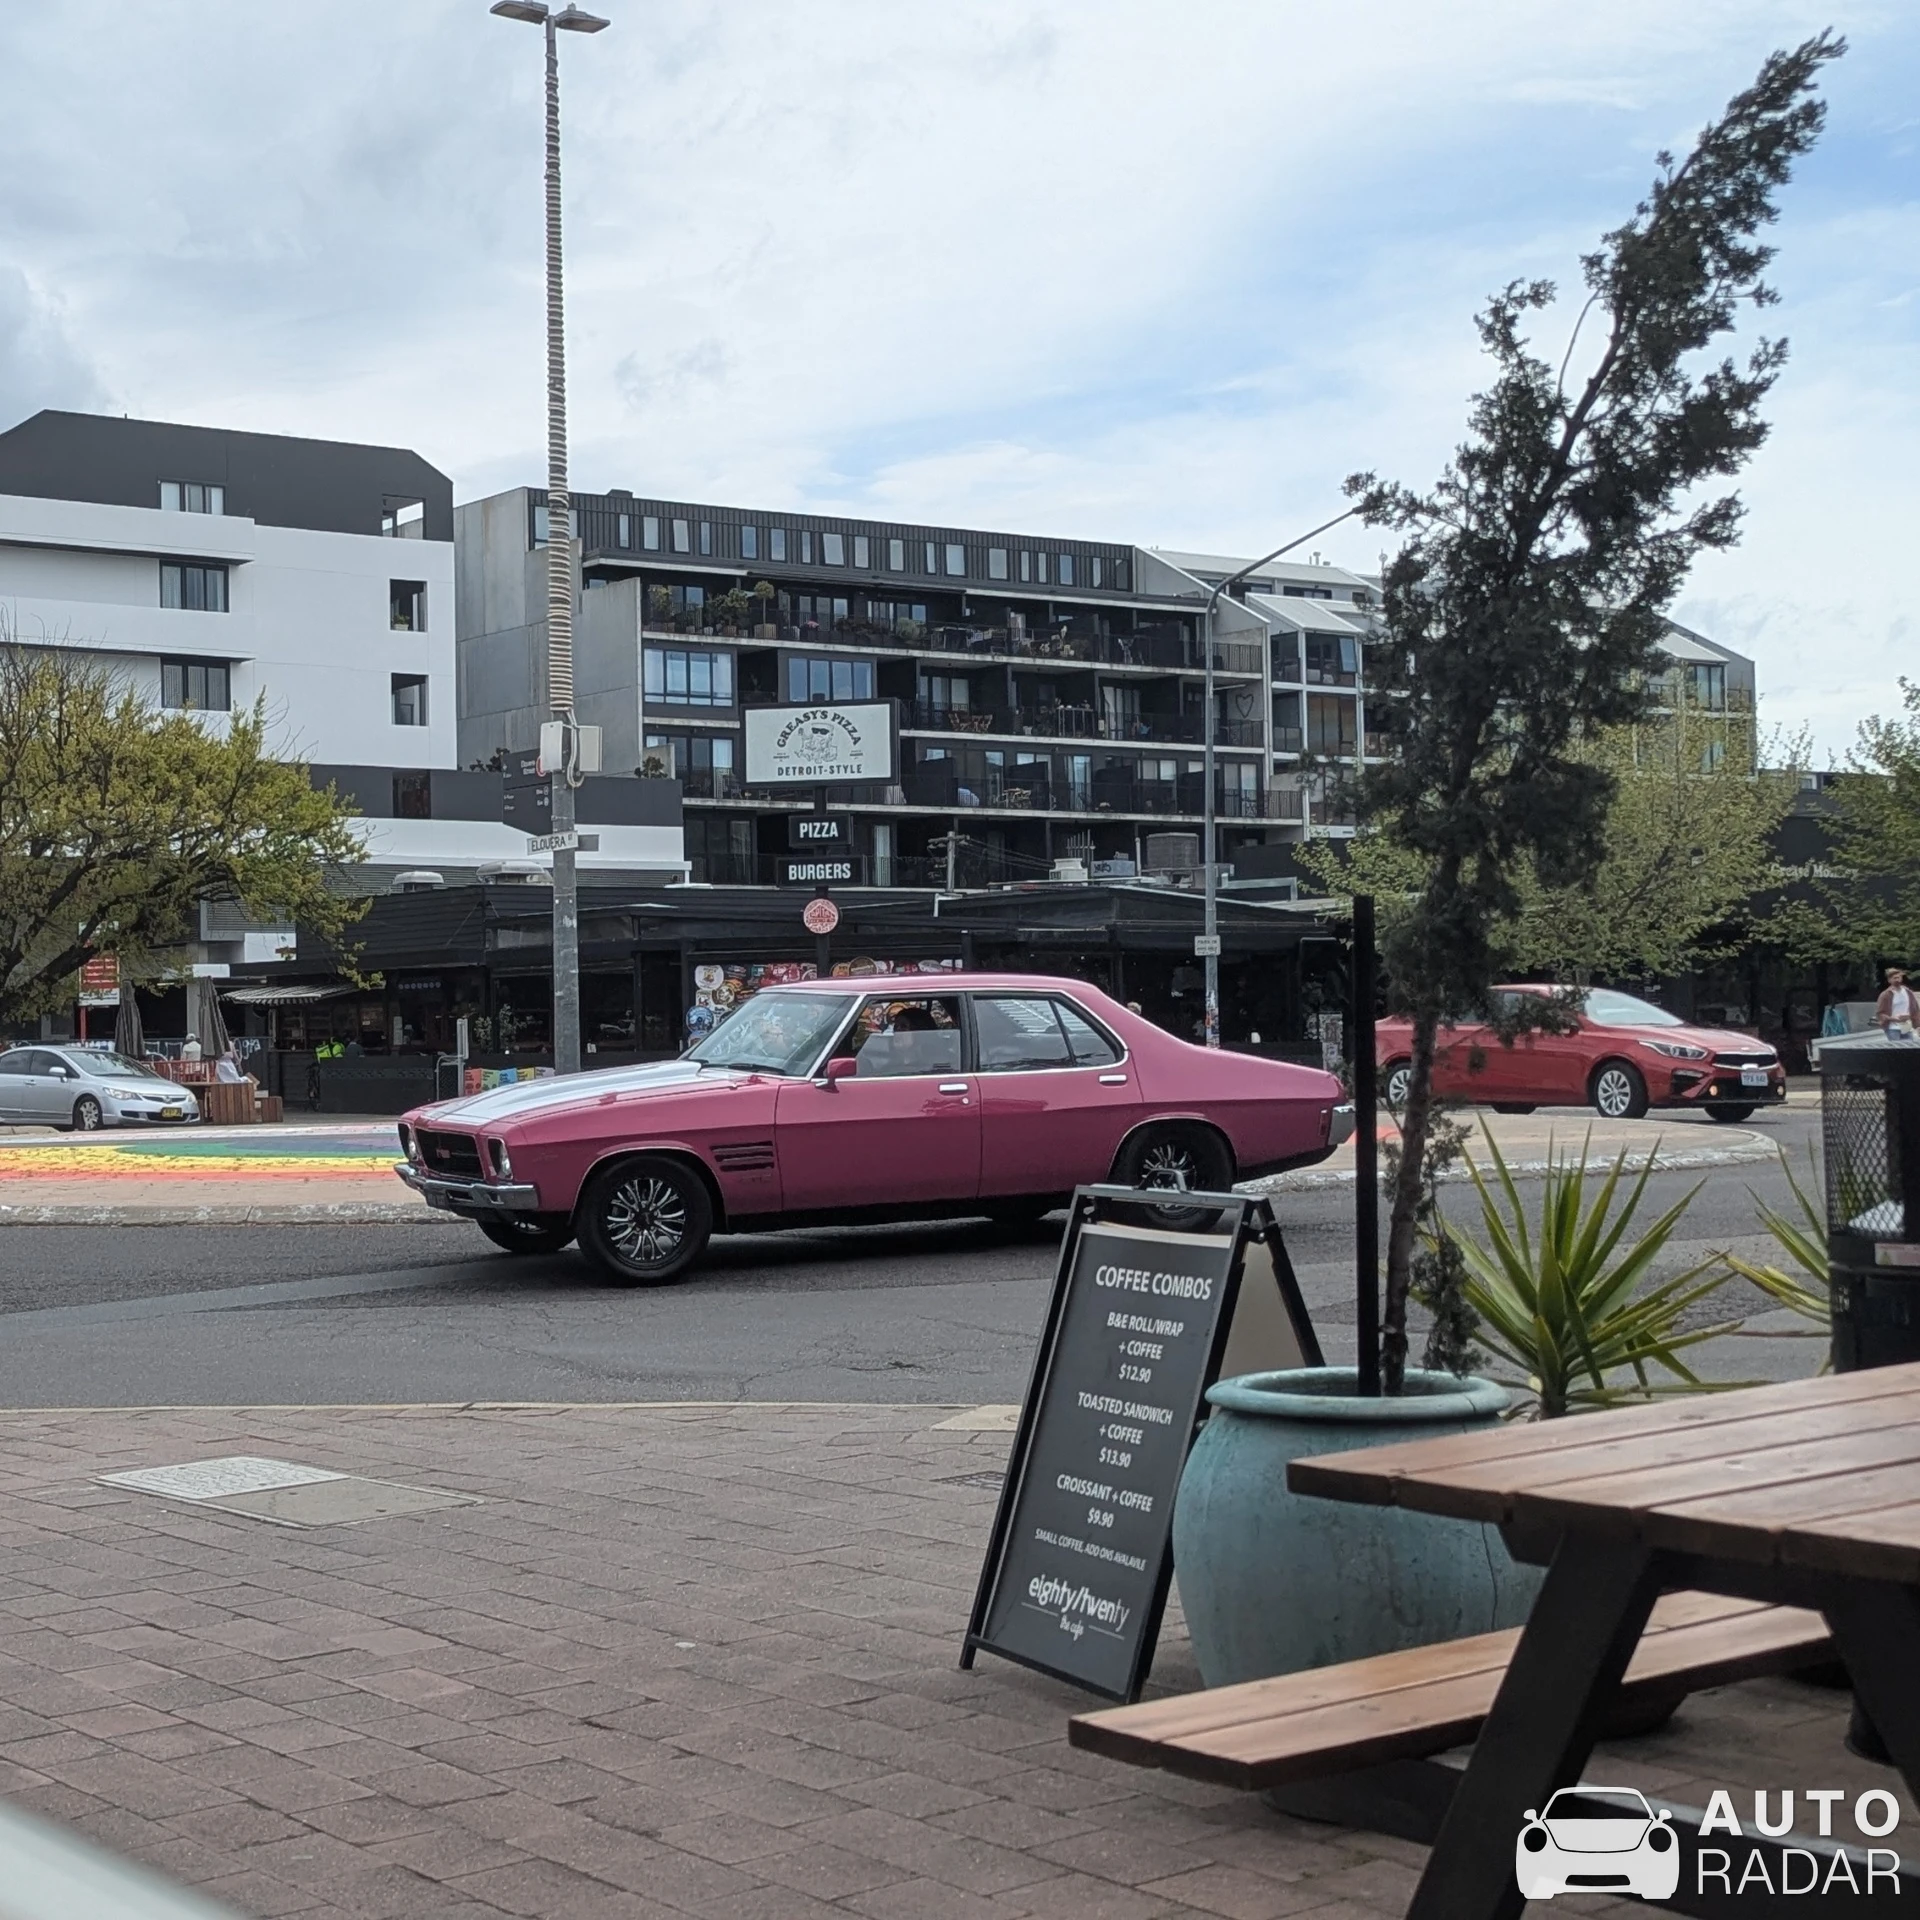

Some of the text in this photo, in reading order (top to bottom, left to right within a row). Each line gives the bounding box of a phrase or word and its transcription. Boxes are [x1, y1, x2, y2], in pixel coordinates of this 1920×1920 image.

[777, 710, 861, 747] GREASY'S PIZZA
[778, 764, 862, 776] DETROIT-STYLE
[800, 822, 838, 838] PIZZA
[531, 836, 566, 851] ELOUERA
[788, 864, 851, 880] BURGERS
[1095, 1265, 1212, 1300] COFFEE COMBOS
[1107, 1312, 1184, 1337] B&E ROLL/WRAP
[1127, 1340, 1163, 1360] COFFEE
[1119, 1363, 1151, 1383] $12.90
[1078, 1392, 1173, 1425] TOASTED SANDWICH
[1108, 1423, 1143, 1444] COFFEE
[1099, 1446, 1131, 1468] $13.90
[1057, 1474, 1112, 1501] CROISSANT
[1119, 1490, 1153, 1512] COFFEE
[1087, 1507, 1114, 1528] $9.90
[1035, 1528, 1058, 1545] SMALL
[1084, 1543, 1100, 1557] ADD
